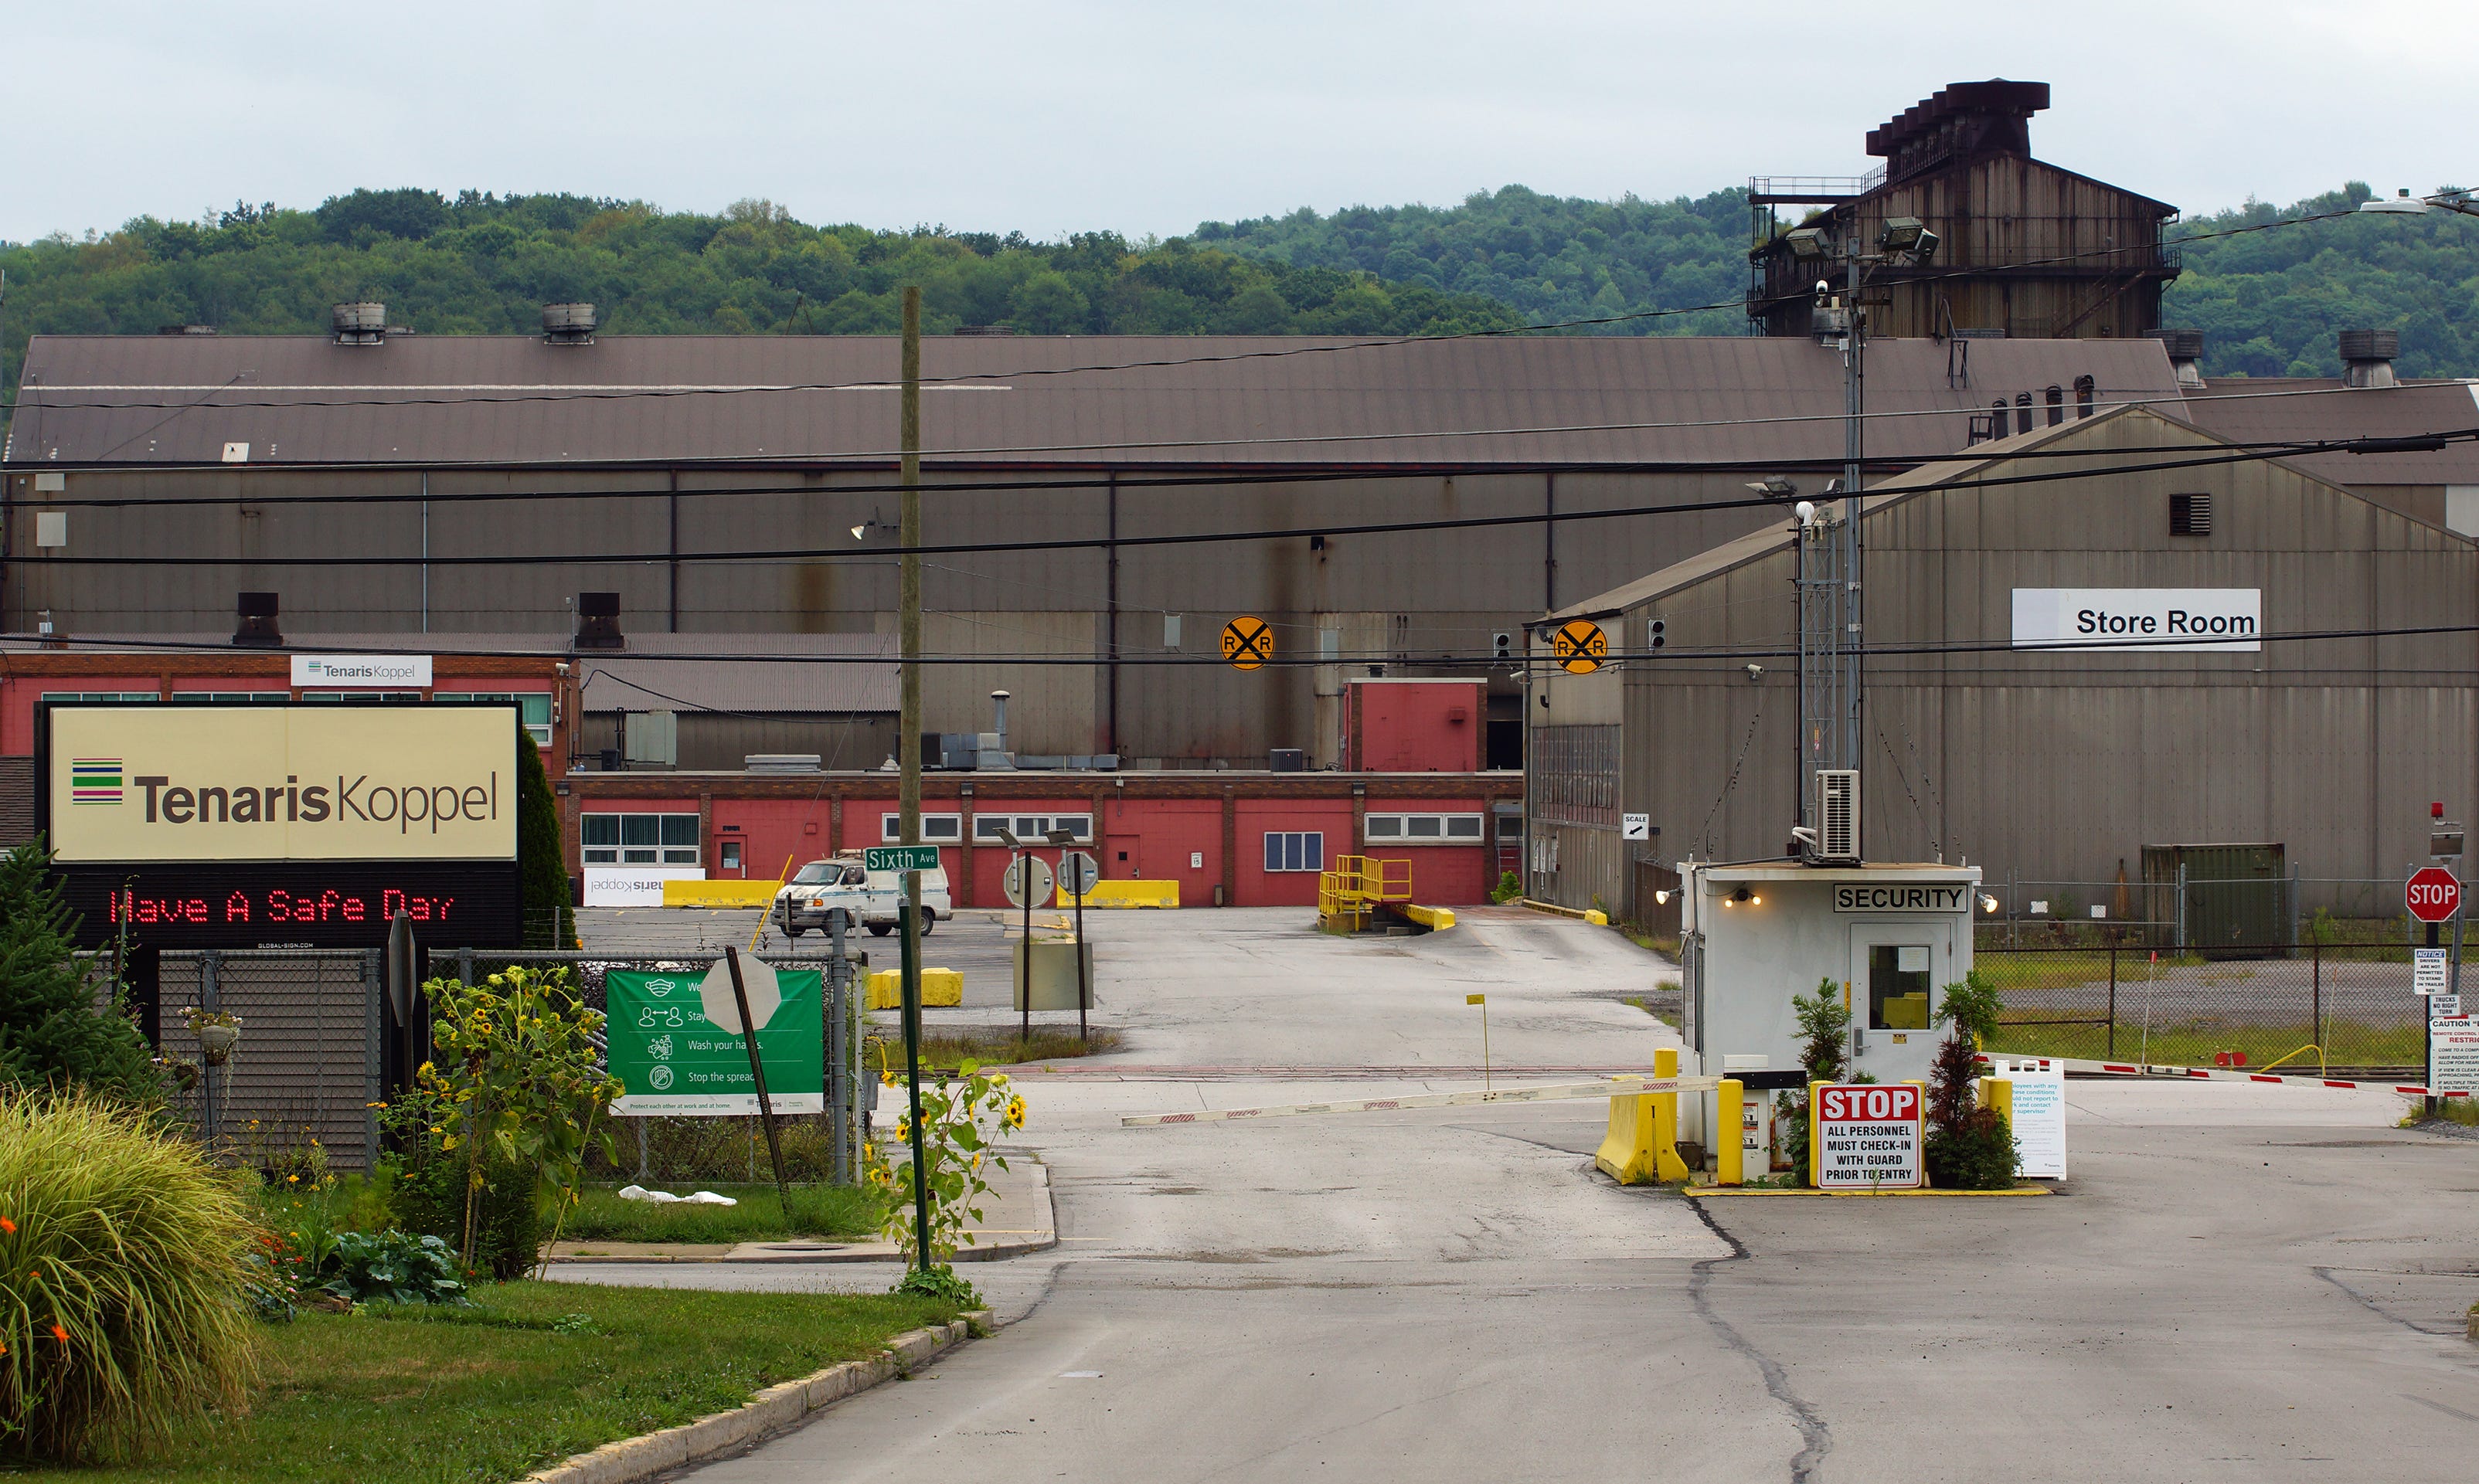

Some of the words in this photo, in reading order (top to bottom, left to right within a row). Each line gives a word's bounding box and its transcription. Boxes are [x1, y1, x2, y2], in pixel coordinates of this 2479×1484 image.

[2077, 609, 2156, 633] Store
[2168, 610, 2255, 633] Room
[1224, 636, 1236, 650] R
[1260, 636, 1271, 650] R
[1557, 641, 1569, 655] R
[1593, 640, 1604, 654] R
[324, 664, 415, 680] TenarisKoppel
[134, 771, 497, 834] TenarisKoppel
[869, 851, 914, 868] Sixth
[920, 853, 935, 863] Ave
[1838, 888, 1963, 908] SECURITY
[2409, 884, 2457, 905] STOP
[111, 891, 209, 923] Have
[226, 891, 250, 922] A
[268, 890, 365, 922] Safe
[383, 889, 454, 921] Day
[688, 1010, 706, 1023] Stay
[688, 1040, 711, 1050] Wash
[714, 1042, 733, 1052] your
[735, 1039, 763, 1050] has.
[688, 1071, 708, 1084] Stop
[710, 1071, 725, 1082] the
[1824, 1090, 1914, 1119] STOP
[1828, 1126, 1846, 1136] ALL
[1850, 1126, 1911, 1136] PERSONNEL
[1828, 1141, 1857, 1151] MUST
[1861, 1140, 1911, 1150] CHECK-IN
[1836, 1155, 1863, 1165] WITH
[1867, 1155, 1903, 1165] GUARD
[1826, 1170, 1858, 1180] PRIOR
[1862, 1170, 1876, 1180] TO
[1879, 1169, 1912, 1180] ENTRY
